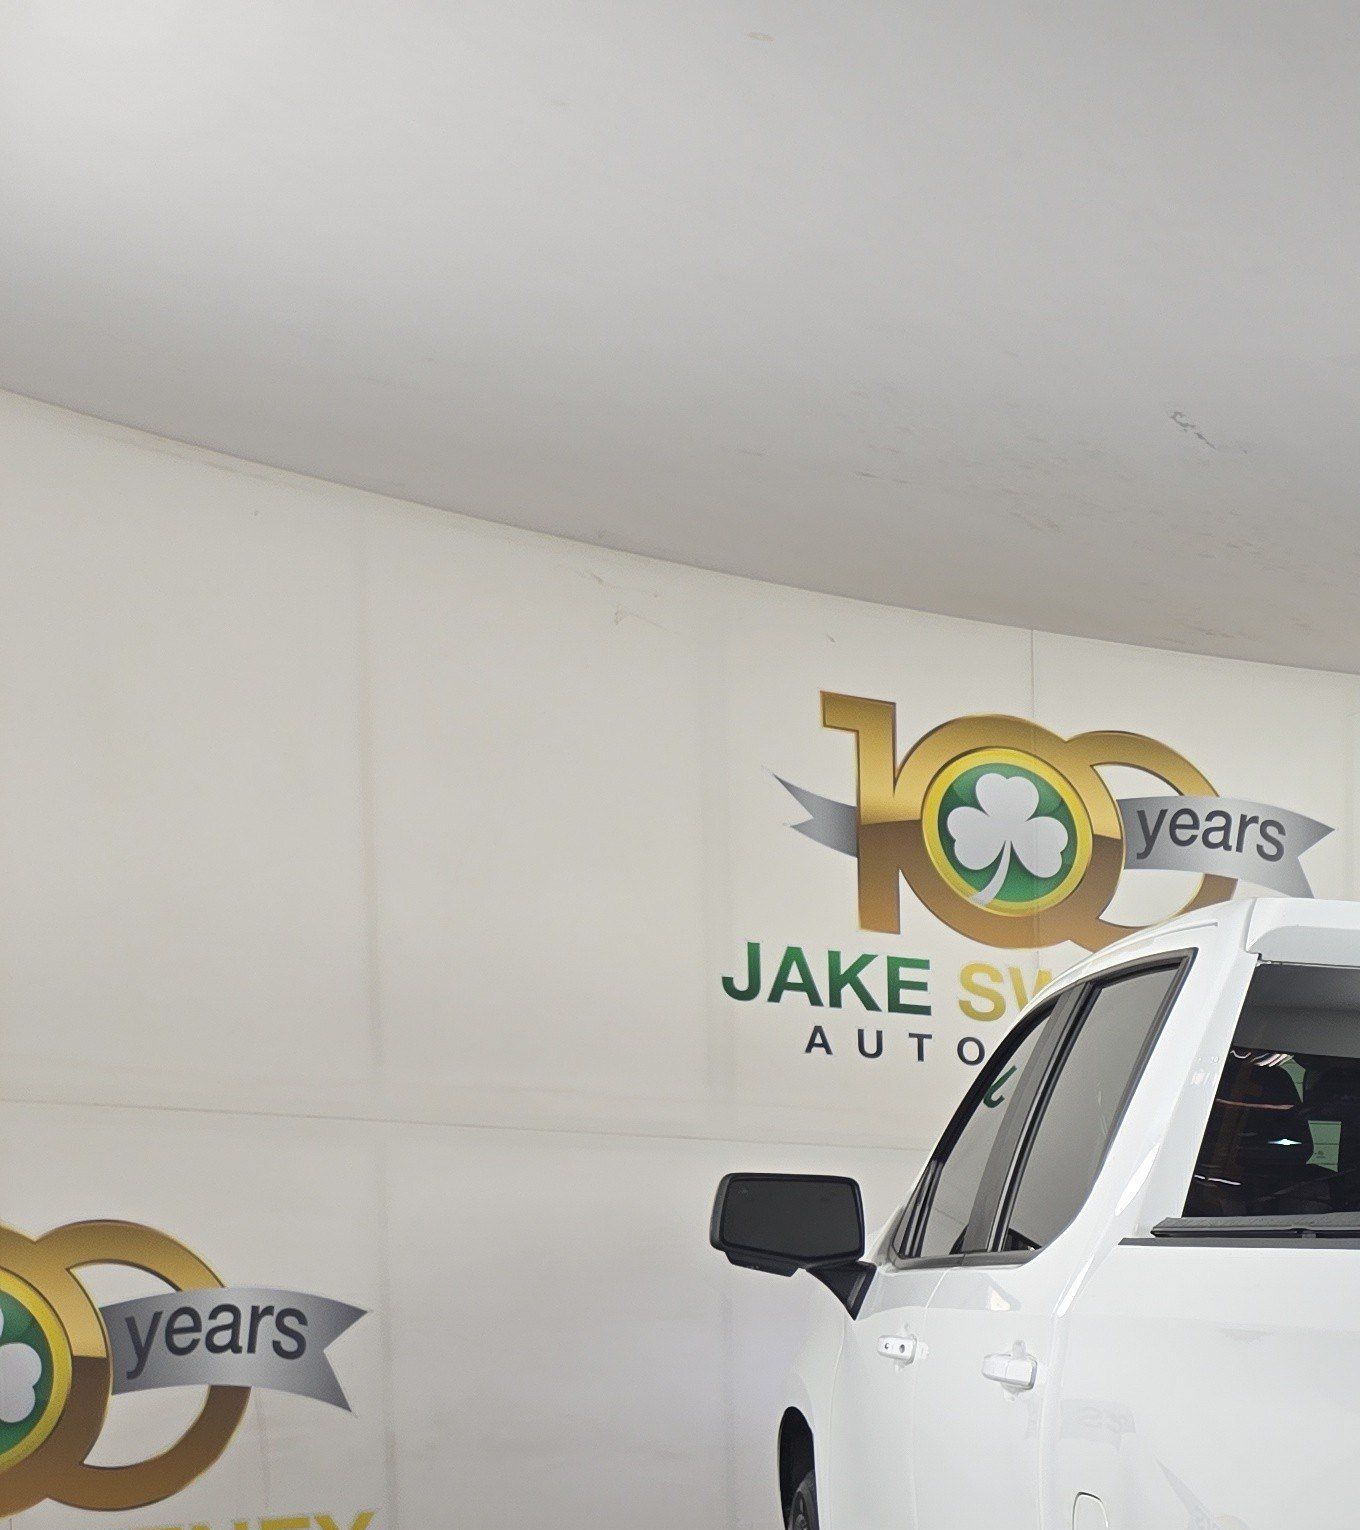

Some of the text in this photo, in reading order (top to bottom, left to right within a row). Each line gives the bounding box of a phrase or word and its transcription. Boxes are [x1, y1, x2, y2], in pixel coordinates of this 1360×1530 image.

[1134, 805, 1287, 863] years
[721, 941, 933, 1017] JAKE
[124, 1302, 309, 1380] years
